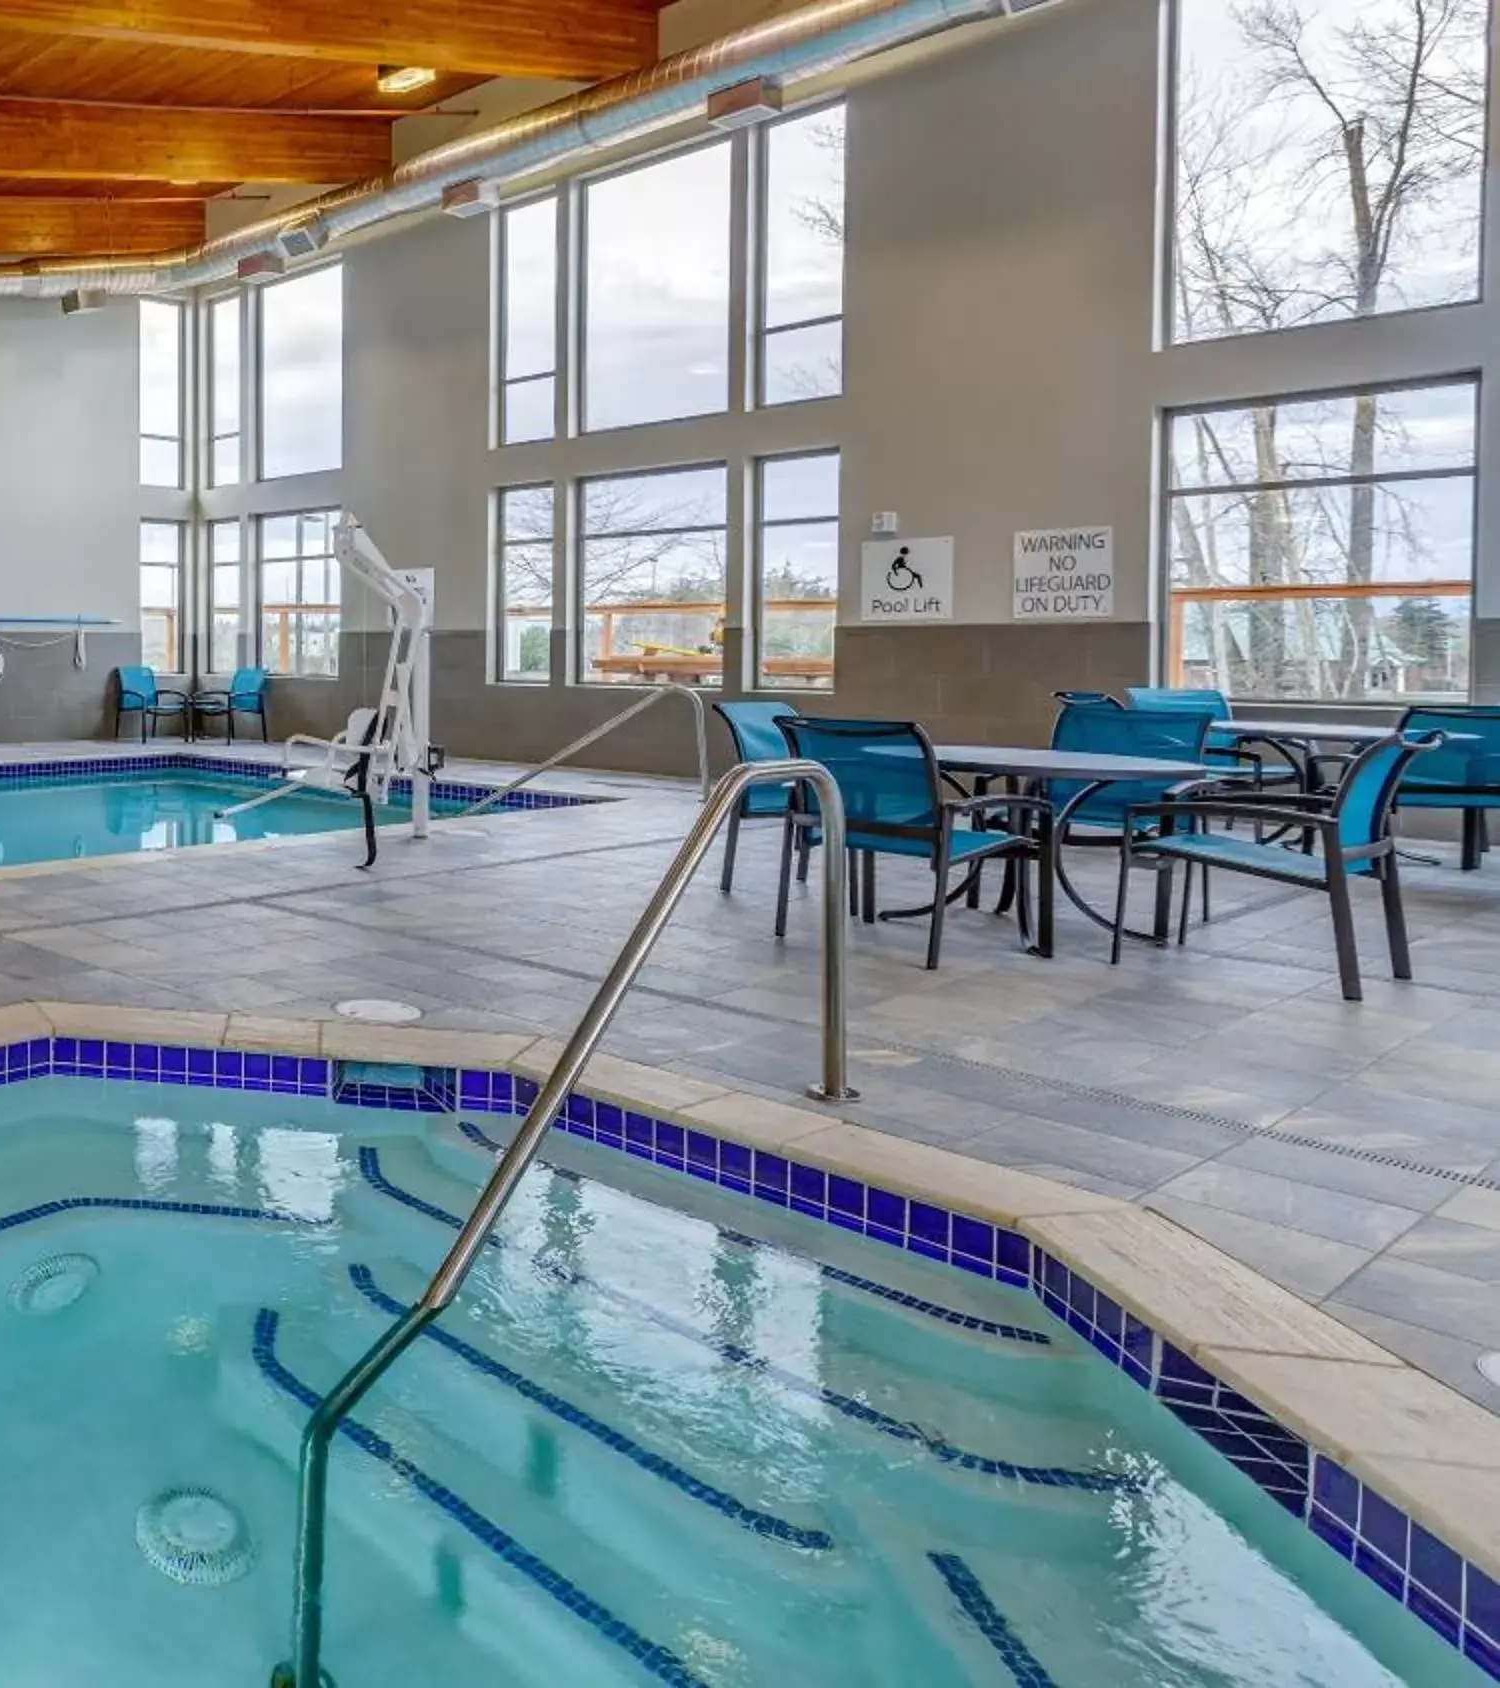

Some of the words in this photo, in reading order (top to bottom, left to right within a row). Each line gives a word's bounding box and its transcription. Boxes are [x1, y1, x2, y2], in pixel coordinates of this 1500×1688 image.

[1021, 534, 1106, 553] WARNING
[1048, 555, 1077, 572] NO
[1015, 573, 1111, 593] LIFEGUARD
[871, 599, 909, 614] Pool
[913, 597, 941, 612] Lift
[1021, 596, 1048, 612] ON
[1053, 595, 1102, 613] DUTY
